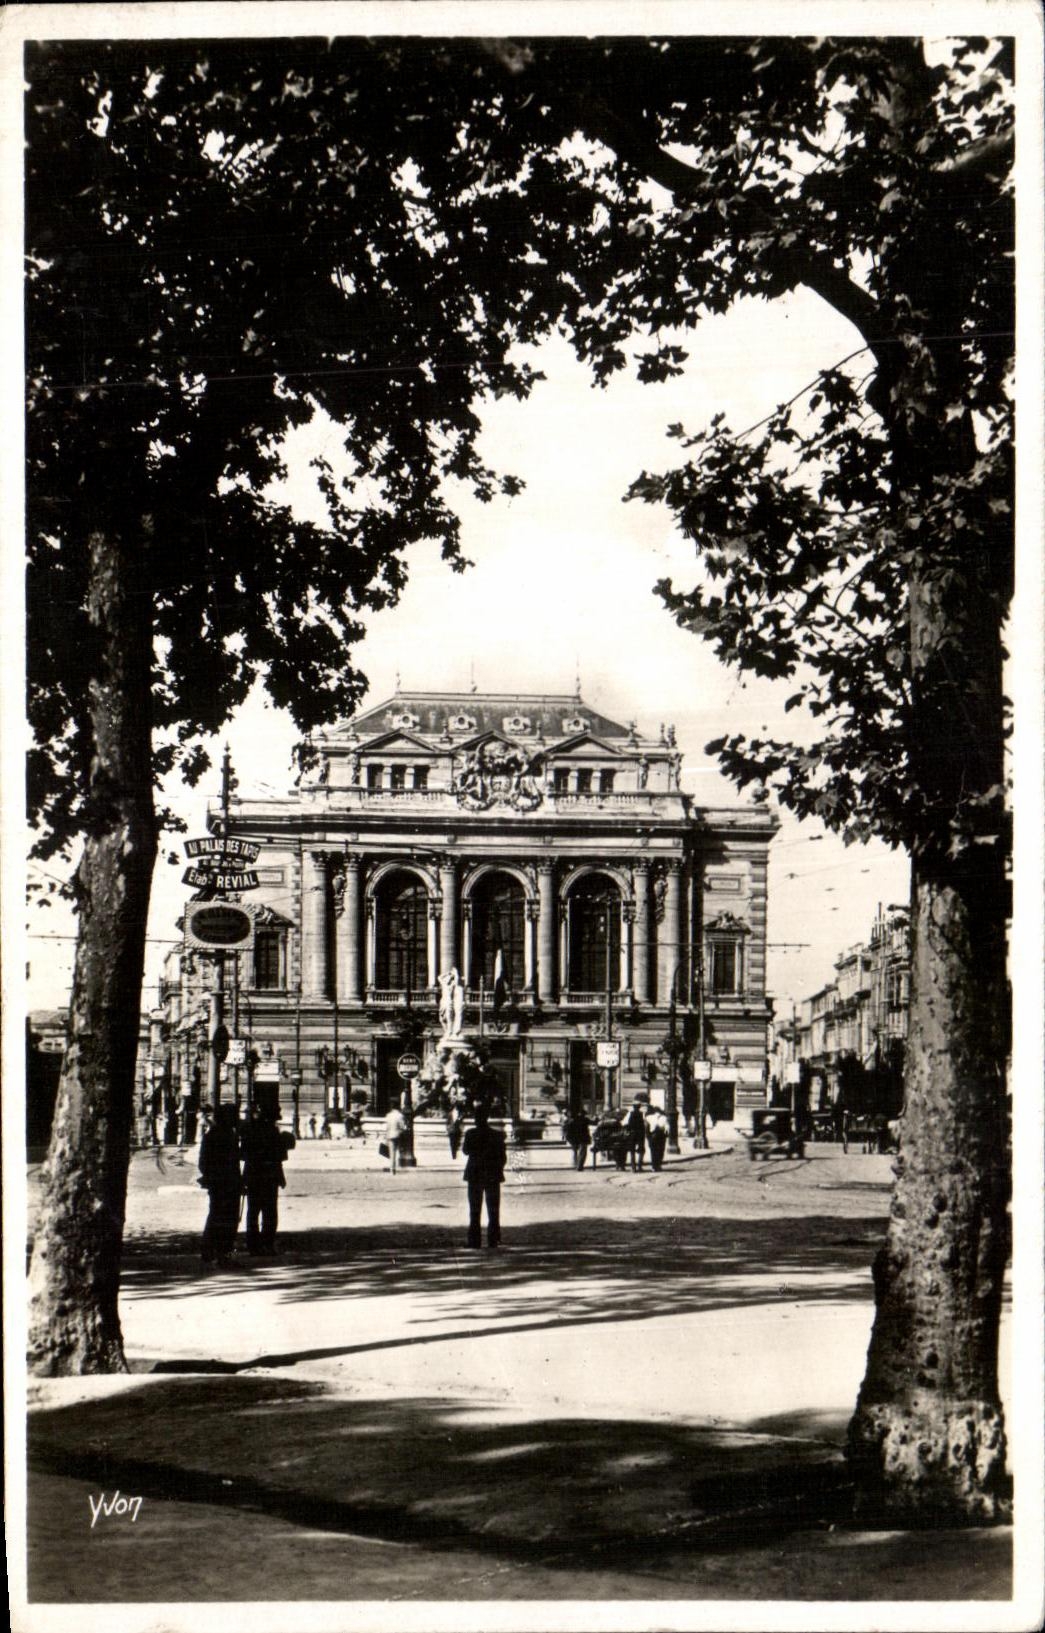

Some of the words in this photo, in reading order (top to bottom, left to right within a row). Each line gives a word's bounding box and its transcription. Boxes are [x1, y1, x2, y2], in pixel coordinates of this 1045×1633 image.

[199, 839, 225, 854] PALAIS
[226, 840, 240, 854] DES
[240, 842, 260, 859] TAPIS
